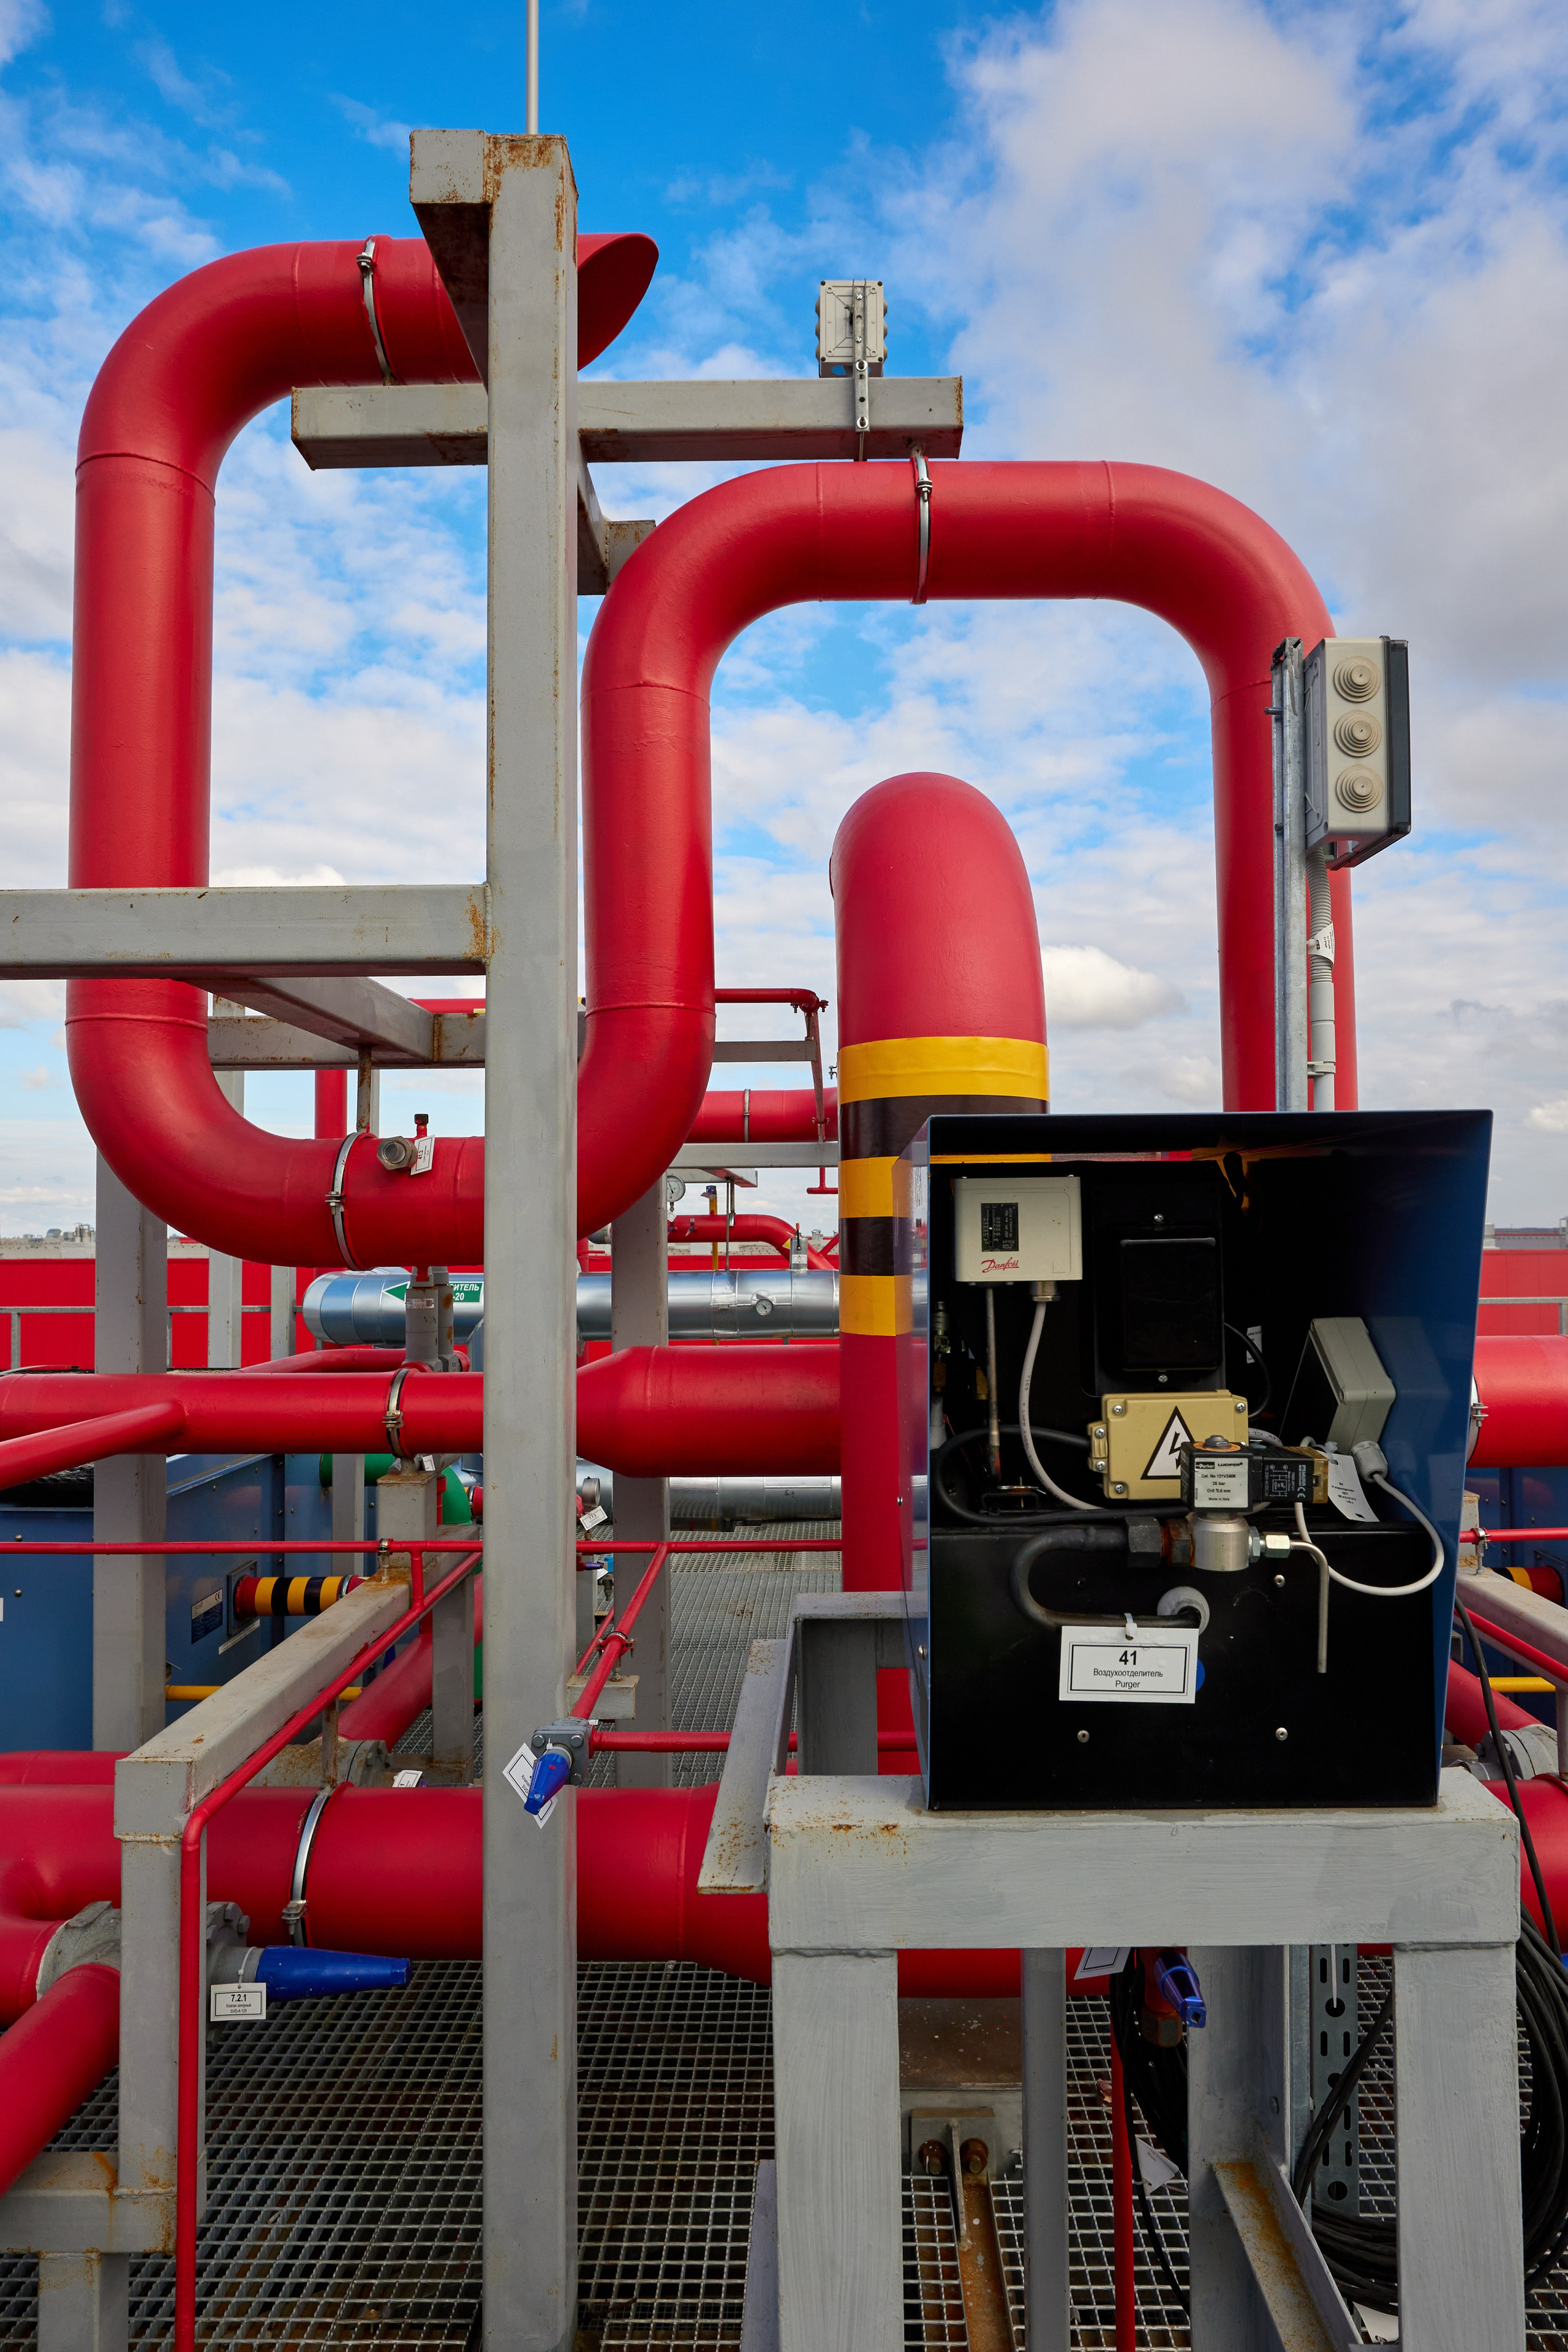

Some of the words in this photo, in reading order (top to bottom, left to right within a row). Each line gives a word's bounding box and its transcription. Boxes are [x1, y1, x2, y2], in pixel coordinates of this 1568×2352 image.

[981, 1257, 1019, 1273] Danfoss
[1119, 1650, 1137, 1665] 41
[1093, 1668, 1163, 1678] Воздухоотделитель
[1115, 1680, 1140, 1689] Purger
